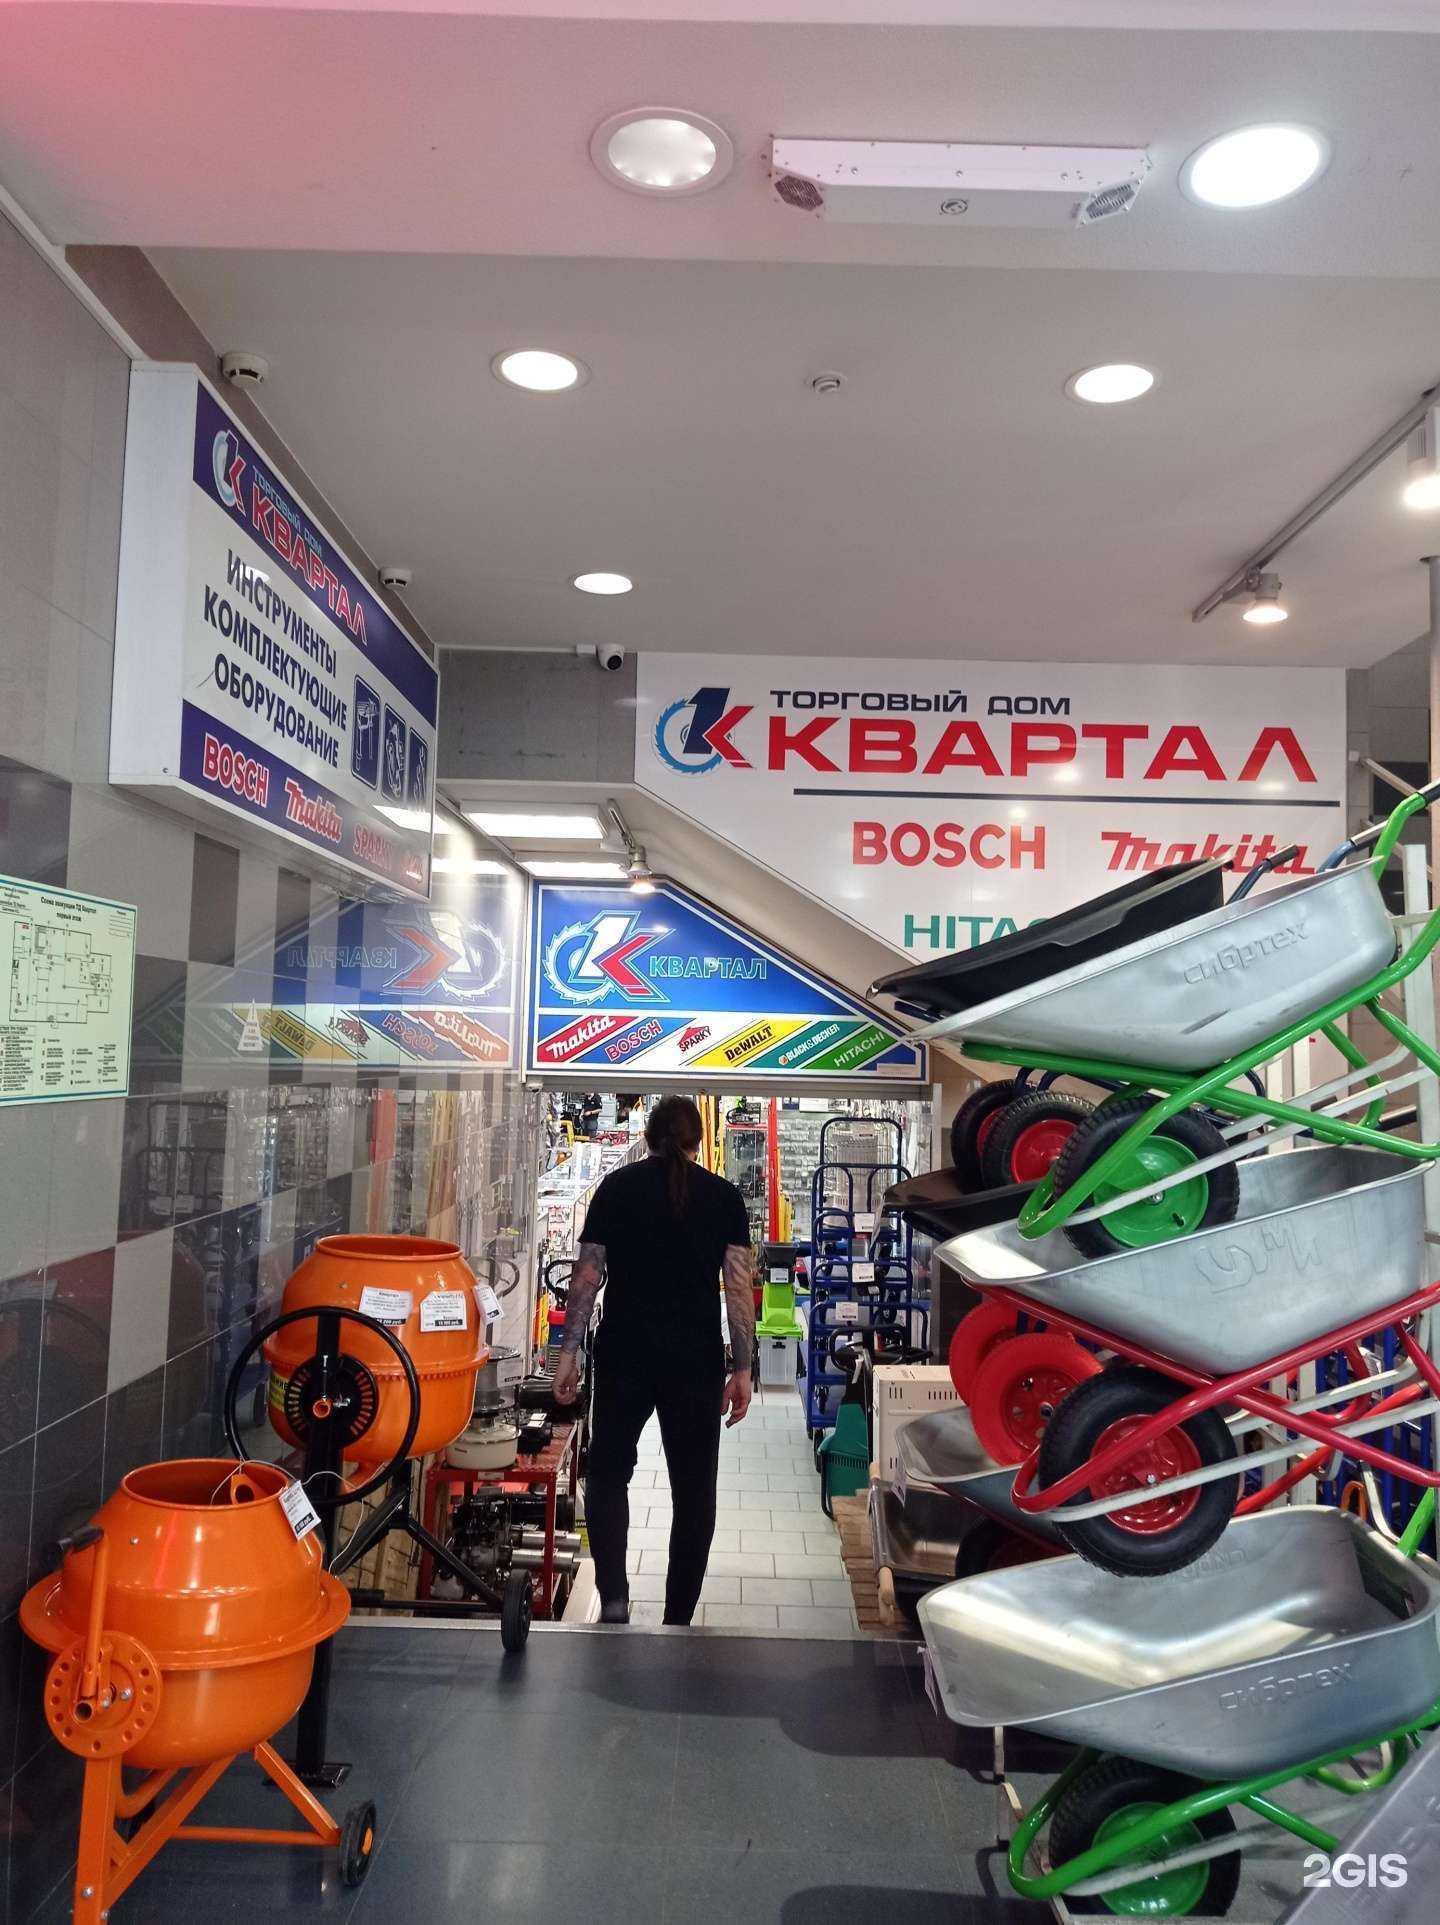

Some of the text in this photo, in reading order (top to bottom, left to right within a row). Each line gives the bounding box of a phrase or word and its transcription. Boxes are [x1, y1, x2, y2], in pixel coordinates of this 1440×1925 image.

[253, 465, 322, 557] ТОРГОВЫЙ ДОМ
[252, 482, 367, 646] КВАРТАЛ
[226, 549, 337, 679] ИНСТРУМЕНТЫ
[204, 585, 347, 731] КОМПЛЕКТУЮЩИЕ
[214, 653, 339, 769] ОБОРУДОВАНИЕ
[770, 690, 1072, 716] ТОРГОВЫЙ ДОМ
[203, 734, 269, 808] BOSCH
[768, 716, 1317, 784] КВАРТАЛ
[853, 821, 1046, 870] BOSCH
[649, 956, 767, 980] КВАРТАЛ
[604, 1018, 664, 1062] BOSCH
[678, 1025, 712, 1054] SPARKY
[725, 1025, 774, 1062] DeWALT
[833, 1032, 885, 1068] HITACHI
